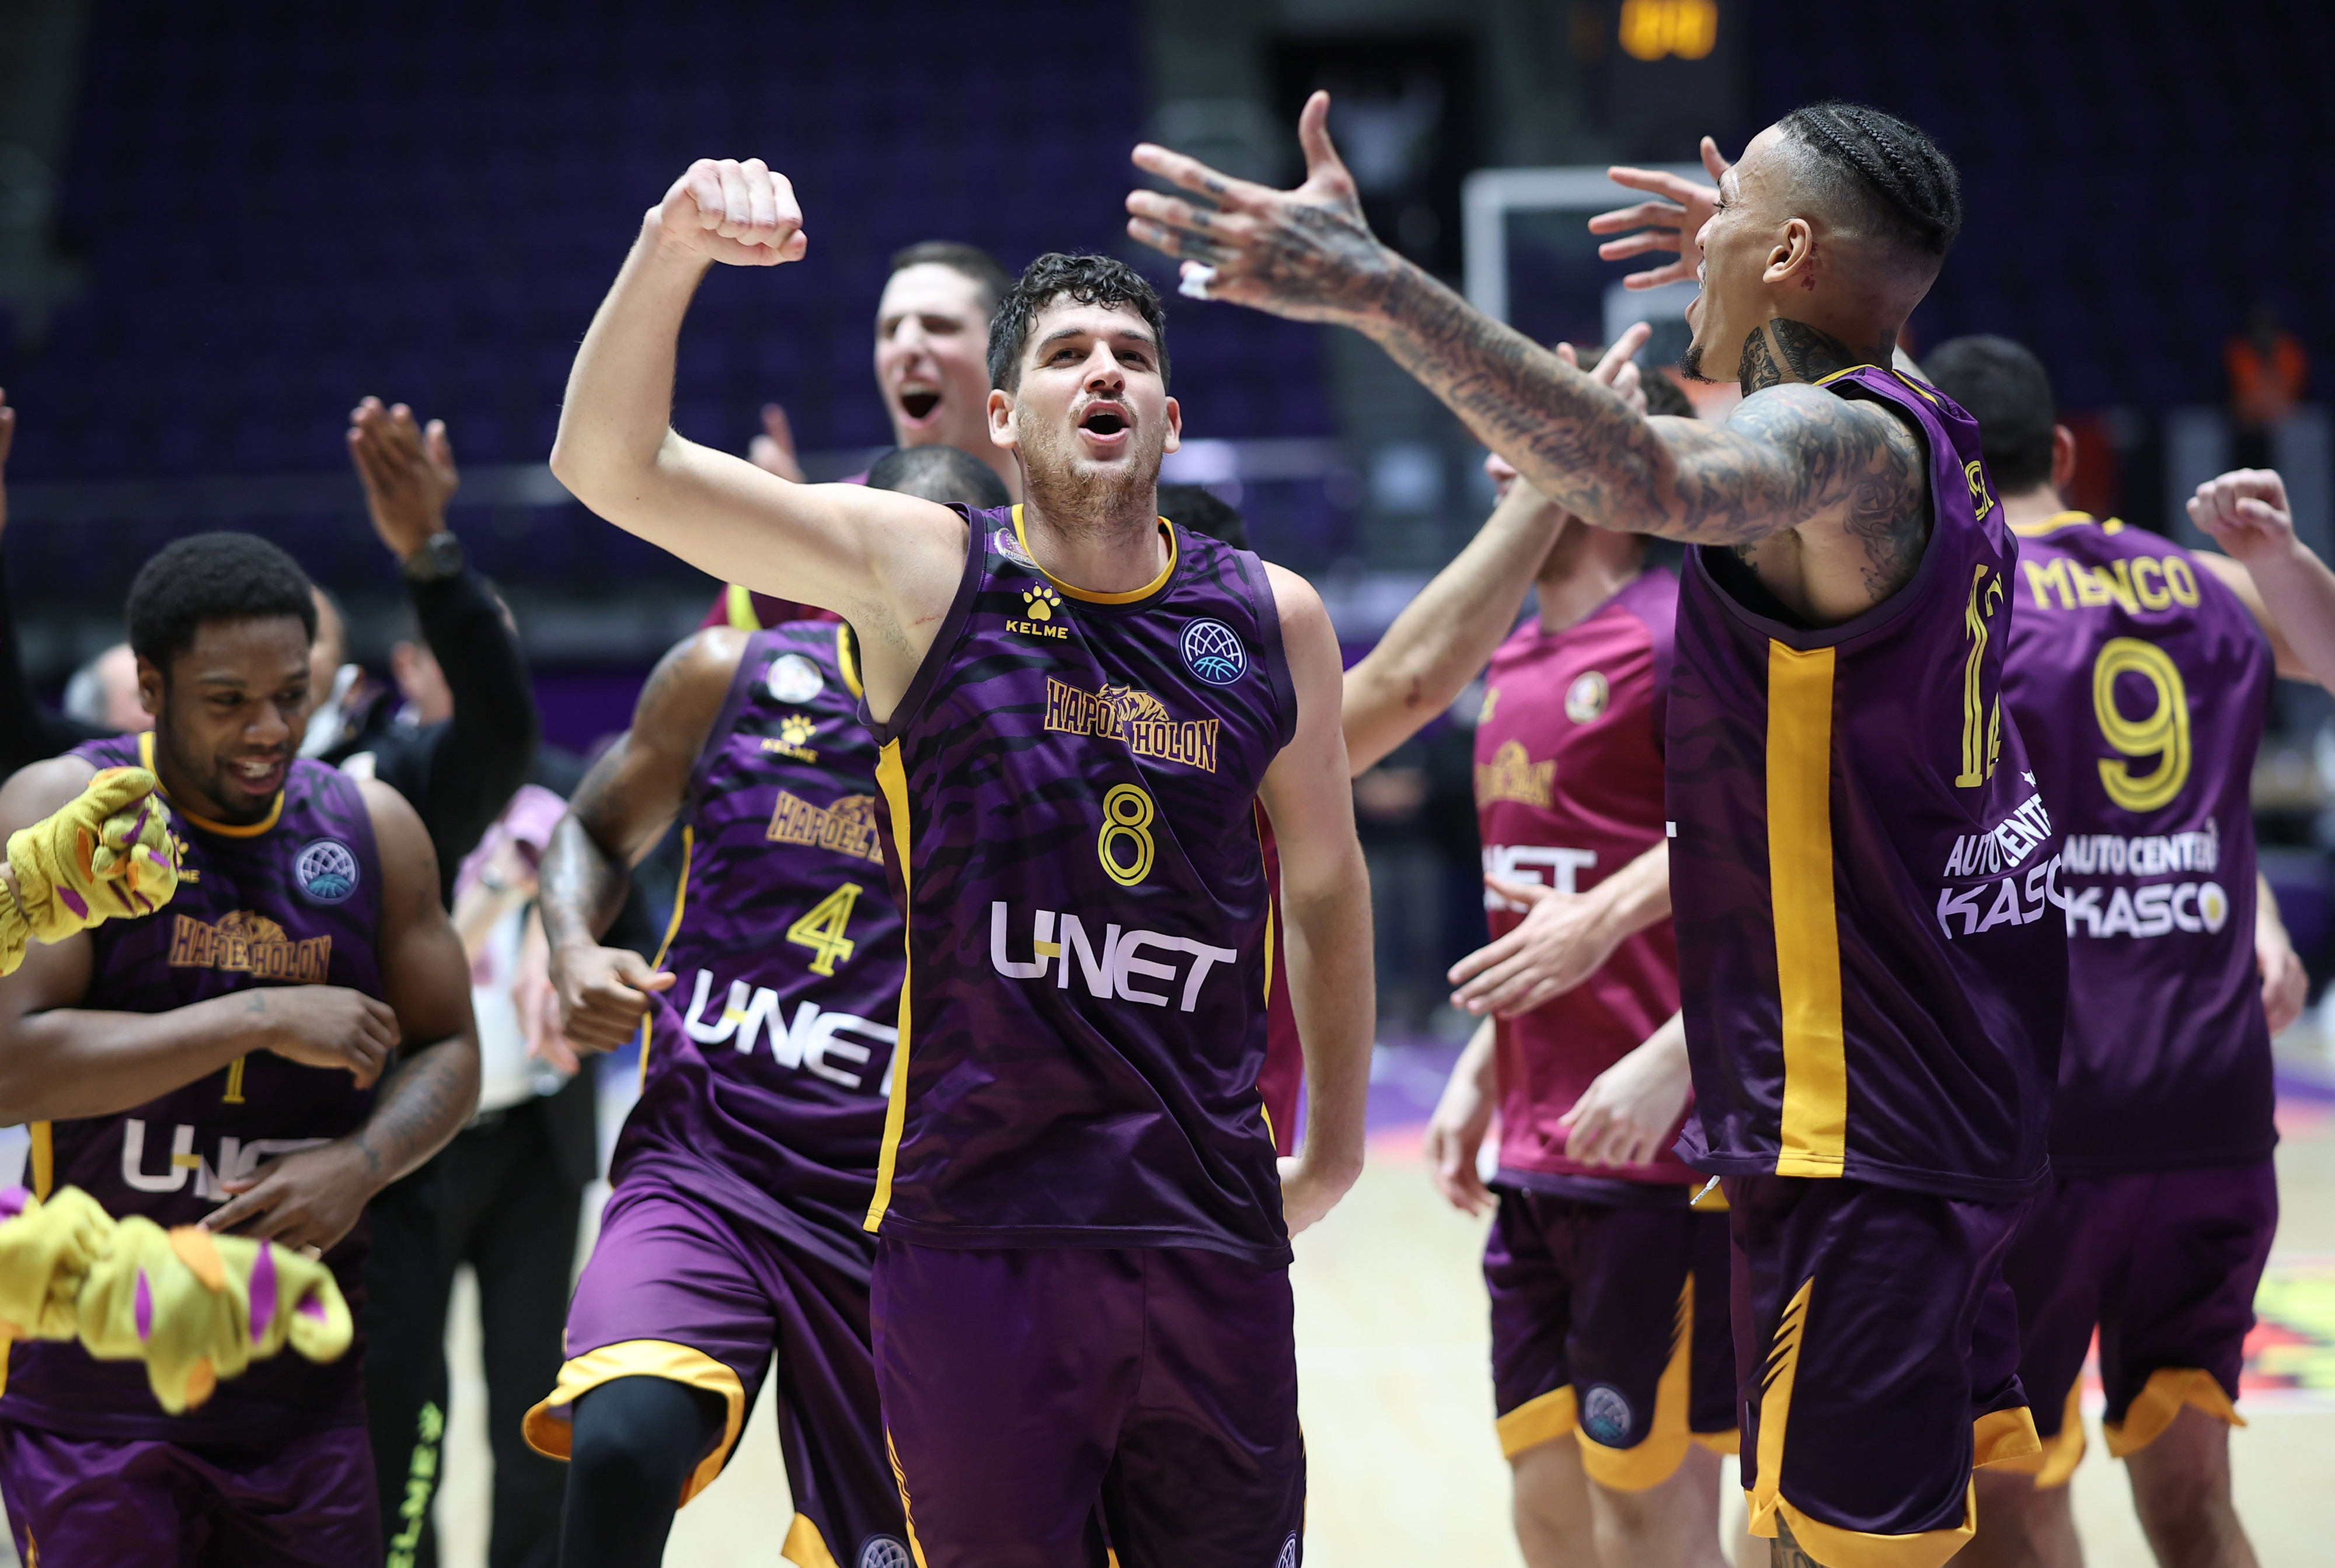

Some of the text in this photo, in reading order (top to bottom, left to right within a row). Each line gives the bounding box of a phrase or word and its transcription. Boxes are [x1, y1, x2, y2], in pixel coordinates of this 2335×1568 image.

[1005, 619, 1069, 639] KELME
[1131, 718, 1219, 774] HOLON
[2093, 637, 2191, 813] 9
[765, 790, 869, 859] HAPOEL
[1098, 783, 1155, 887] 8
[1944, 793, 2052, 876] AUTO CENTE
[2062, 834, 2126, 875] AUTO
[786, 882, 863, 977] 4
[1936, 853, 2066, 940] KASC
[2065, 881, 2228, 938] KASCO
[251, 935, 332, 985] HOLON
